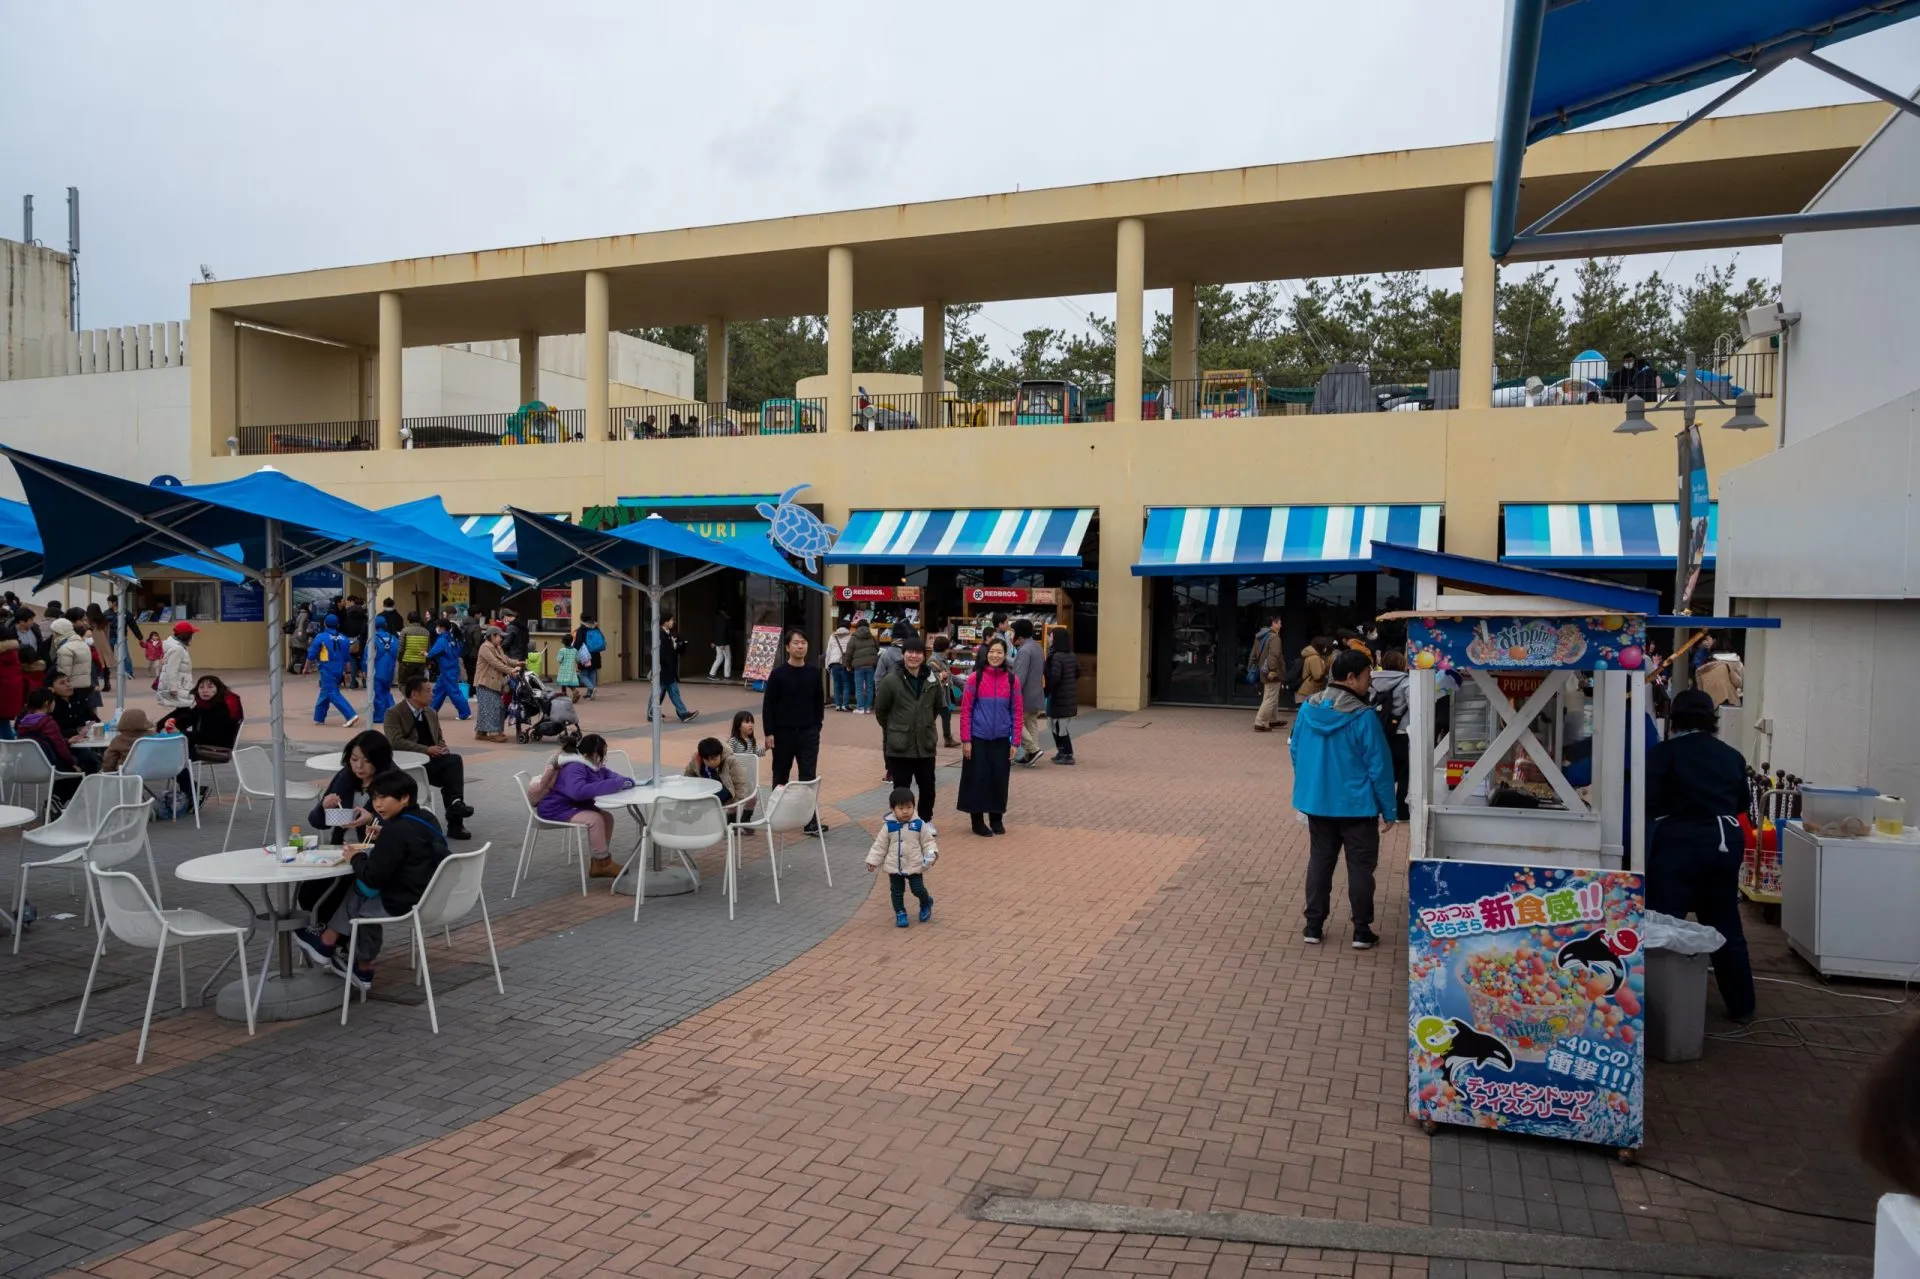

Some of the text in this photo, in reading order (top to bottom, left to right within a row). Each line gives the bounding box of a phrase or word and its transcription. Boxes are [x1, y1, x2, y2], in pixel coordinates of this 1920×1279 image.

[1422, 906, 1475, 923] つぶつぶ
[1431, 919, 1482, 936] さらさら
[1466, 1077, 1594, 1106] ディッピンドッツ
[1471, 1093, 1588, 1123] アイスクリーム
